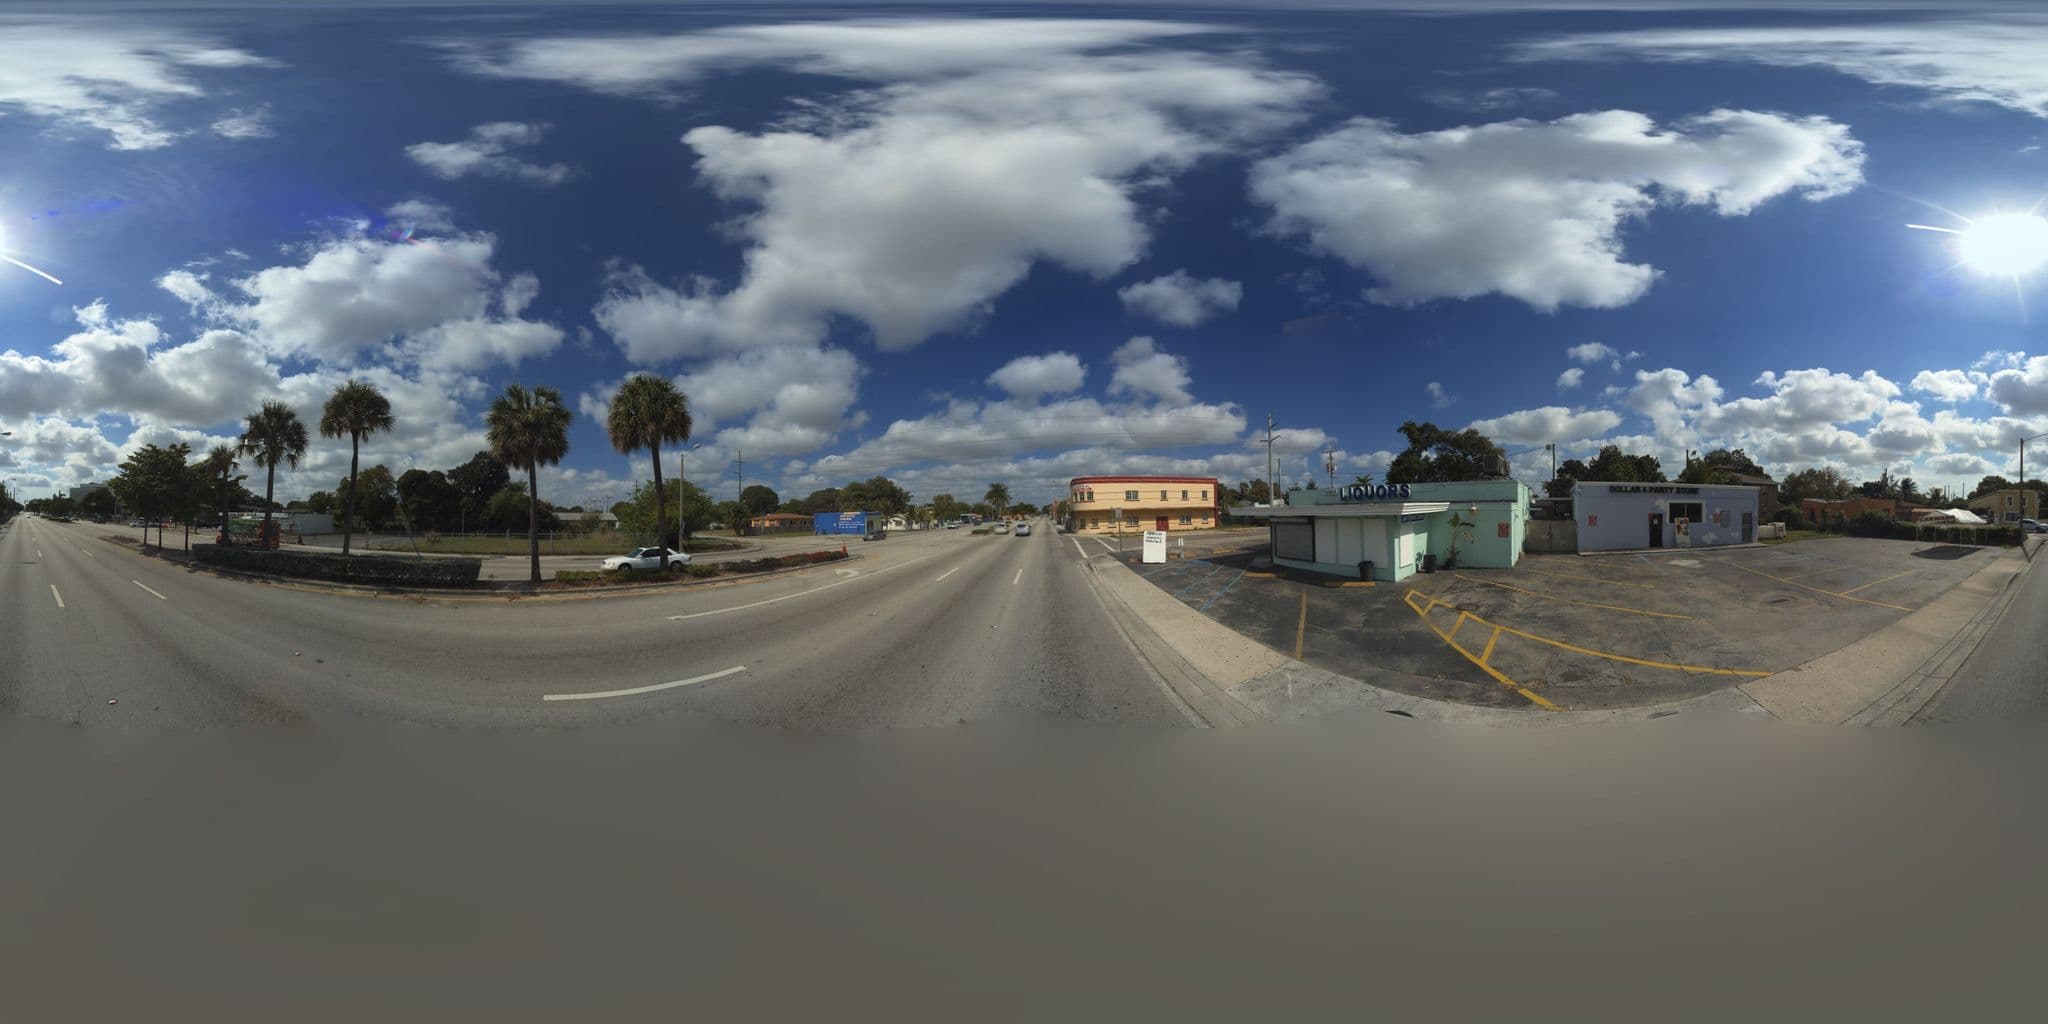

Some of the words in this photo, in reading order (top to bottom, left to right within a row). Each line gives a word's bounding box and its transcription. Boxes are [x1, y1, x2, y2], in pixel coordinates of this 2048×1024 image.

[1339, 484, 1411, 501] LIQUORS
[1609, 485, 1641, 494] DOLLAR
[1649, 486, 1673, 495] PARTY
[1675, 487, 1699, 496] STORE
